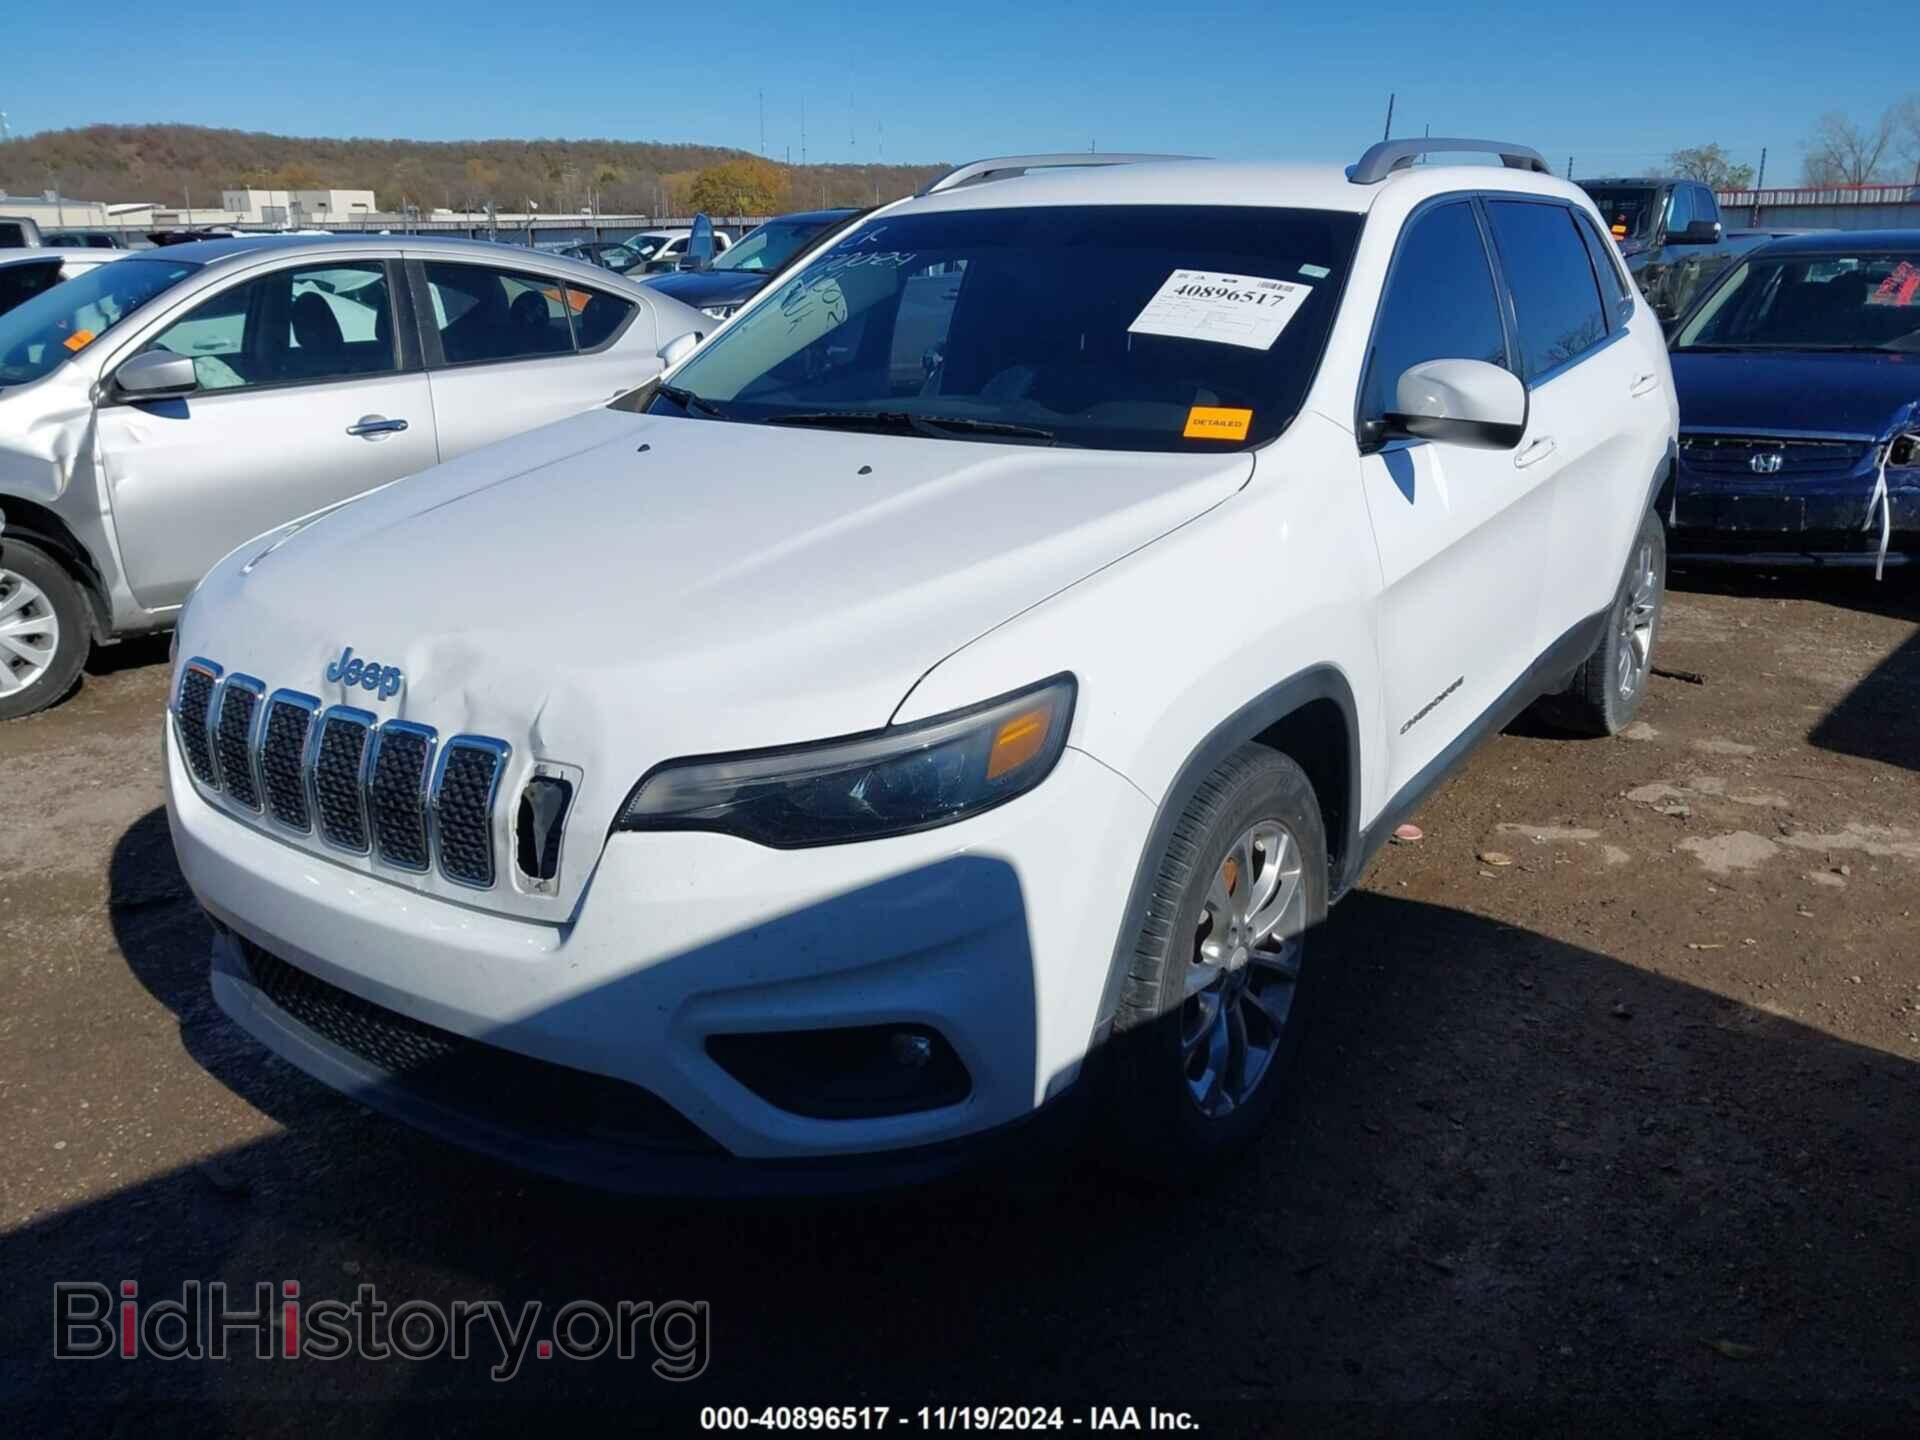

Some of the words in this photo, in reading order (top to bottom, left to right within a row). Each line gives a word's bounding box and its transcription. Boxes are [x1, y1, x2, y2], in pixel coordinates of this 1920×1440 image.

[1173, 283, 1286, 307] 40896517
[1193, 418, 1242, 428] DETAILED
[326, 646, 401, 701] Jeep
